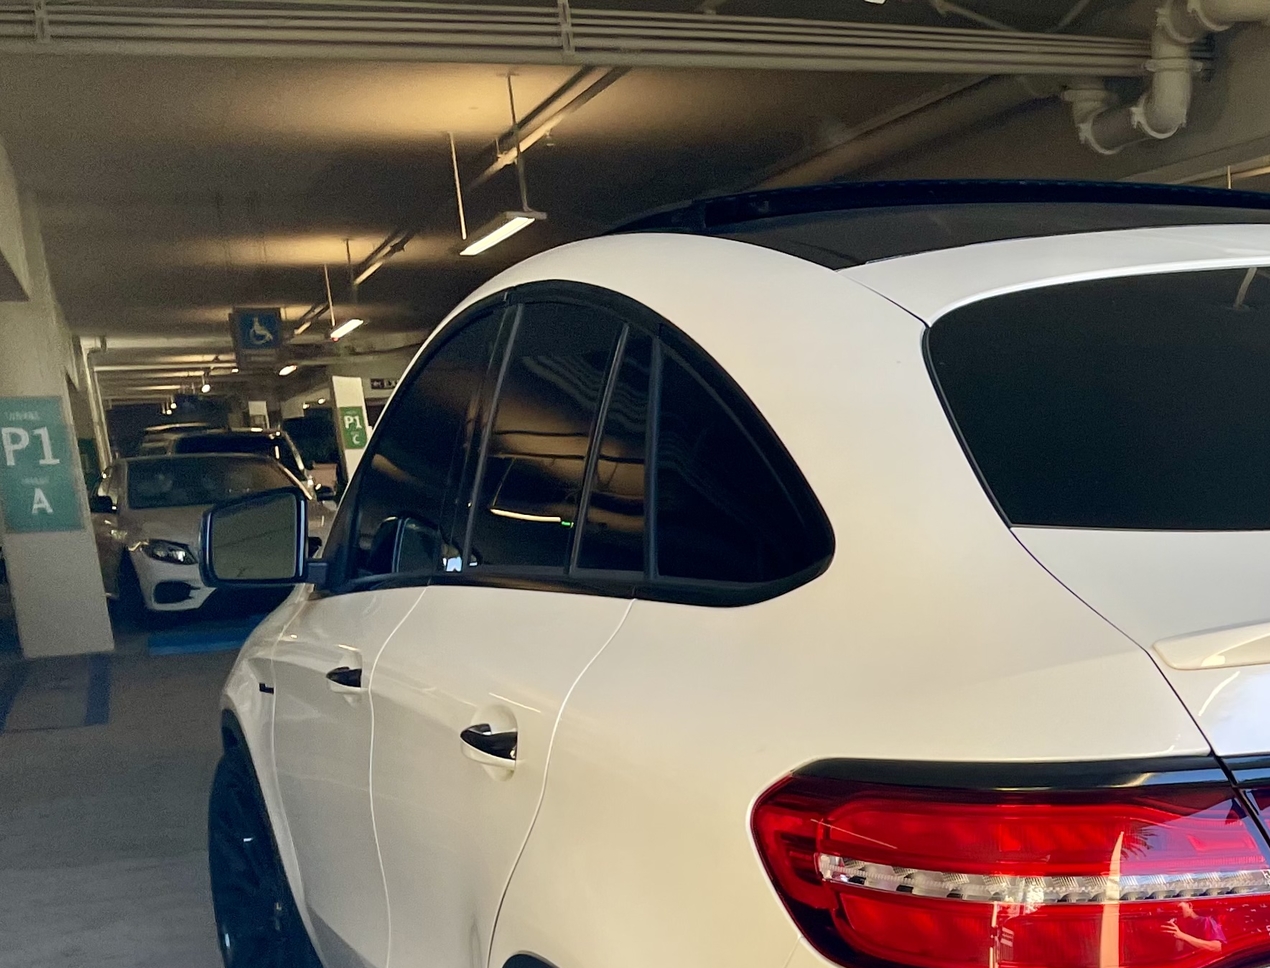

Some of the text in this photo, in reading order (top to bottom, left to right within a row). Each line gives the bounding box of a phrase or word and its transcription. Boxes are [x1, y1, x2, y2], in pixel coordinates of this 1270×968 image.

[343, 415, 362, 429] P1
[1, 426, 60, 466] P1
[352, 434, 360, 445] C
[31, 487, 54, 514] A
